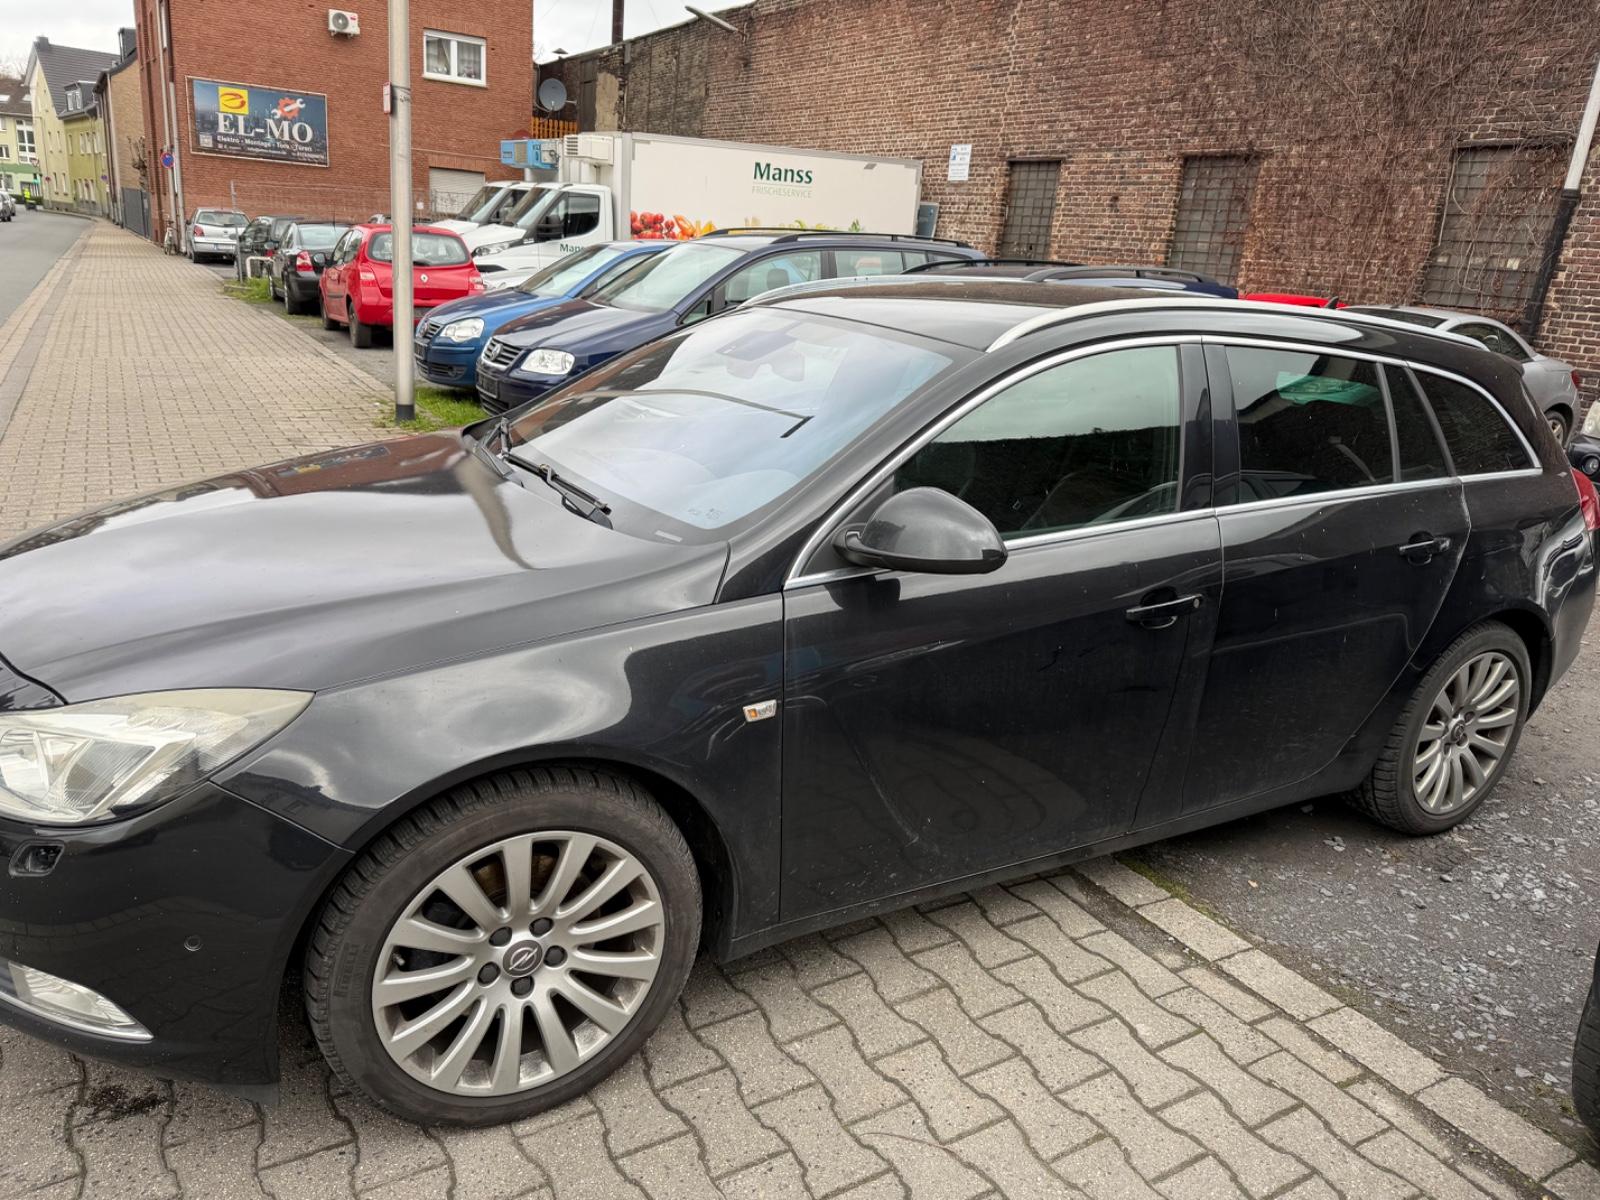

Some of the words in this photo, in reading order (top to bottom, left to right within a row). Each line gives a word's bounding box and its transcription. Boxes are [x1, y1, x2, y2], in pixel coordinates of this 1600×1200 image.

[216, 112, 313, 143] EL-MO
[753, 161, 813, 184] Manss
[752, 185, 812, 198] FRISCHESERVICE
